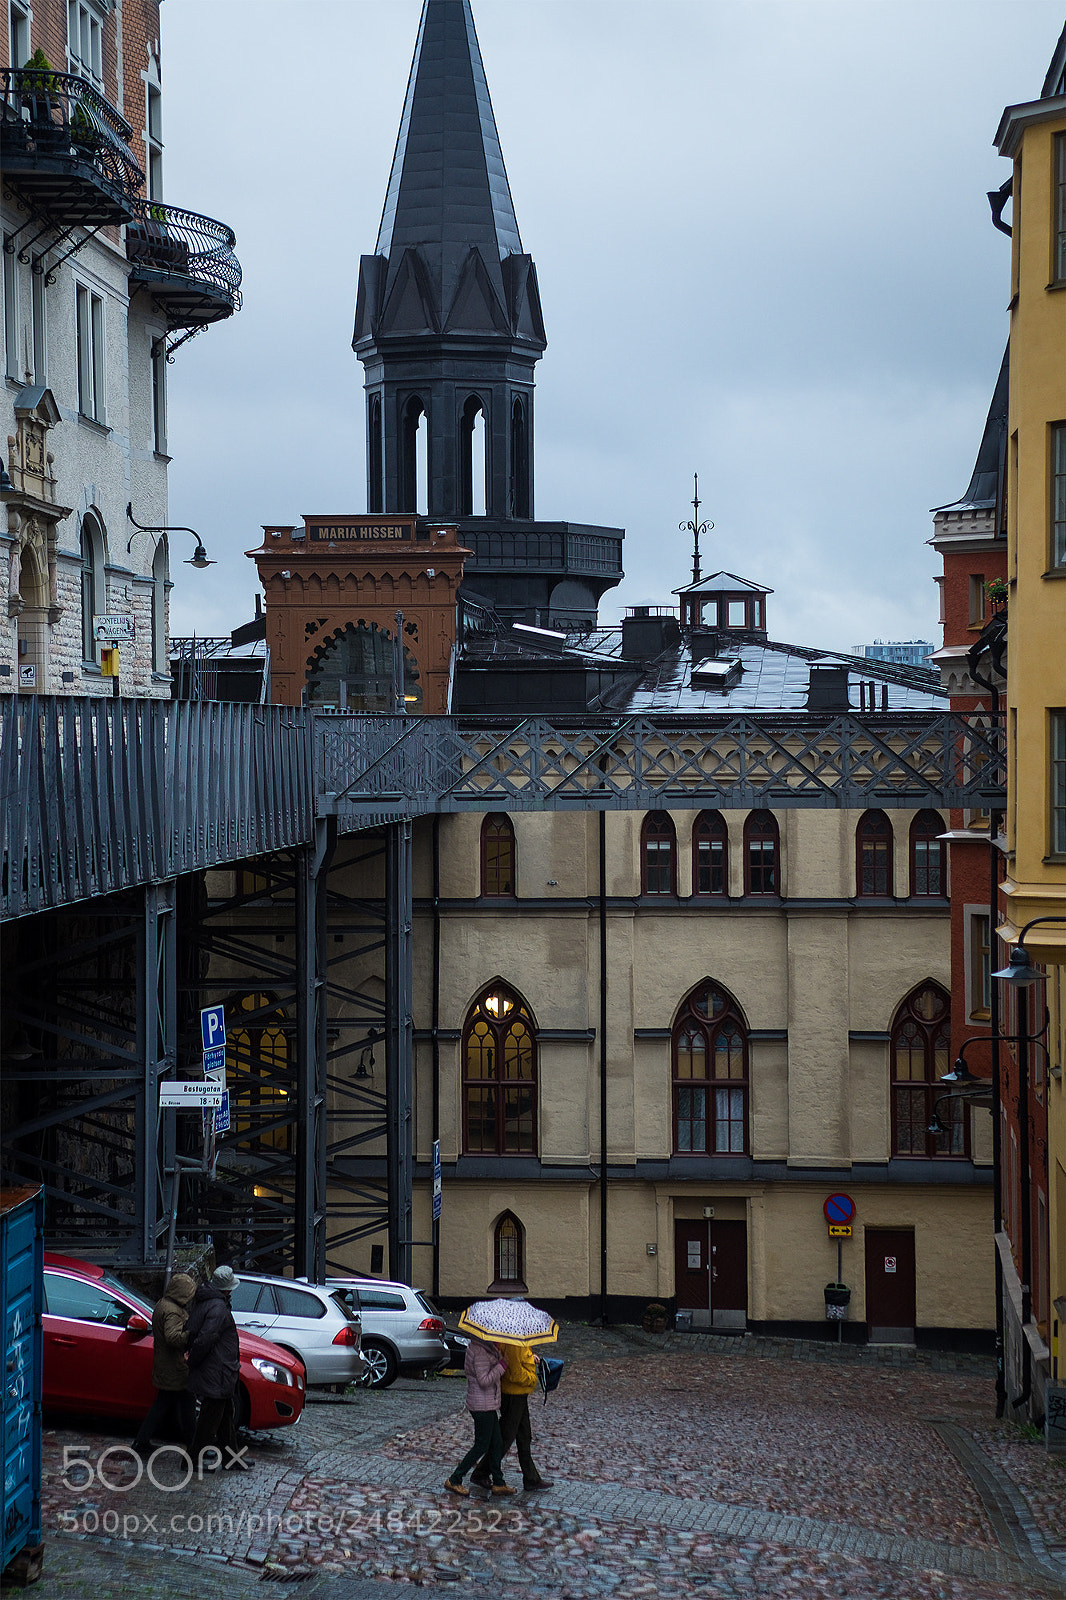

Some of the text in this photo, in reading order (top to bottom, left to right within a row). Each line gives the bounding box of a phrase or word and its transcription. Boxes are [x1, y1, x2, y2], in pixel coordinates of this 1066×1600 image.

[318, 526, 403, 539] MARIA HISSEN
[208, 1013, 218, 1044] P
[183, 1085, 221, 1095] Bastugatan
[199, 1097, 207, 1106] 18
[212, 1097, 220, 1106] 16
